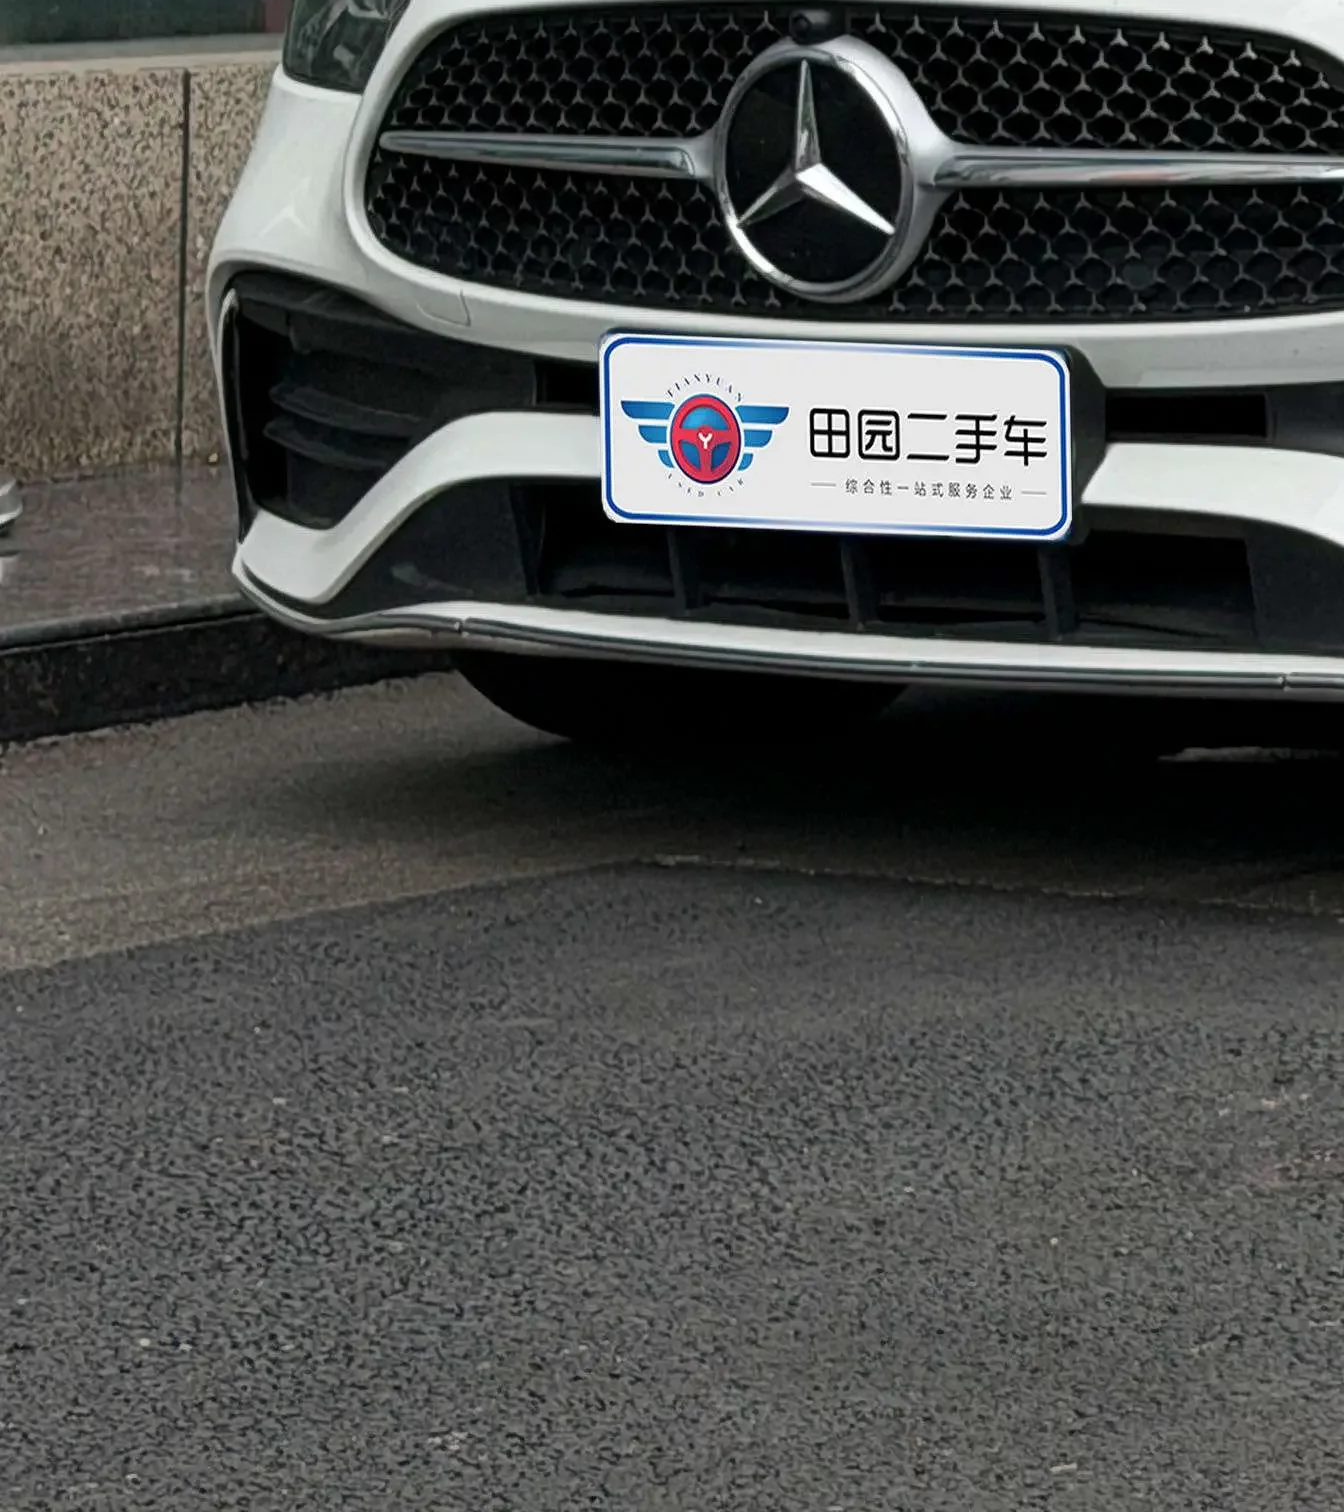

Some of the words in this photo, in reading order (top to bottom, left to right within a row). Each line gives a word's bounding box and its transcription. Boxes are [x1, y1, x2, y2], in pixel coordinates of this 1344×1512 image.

[809, 408, 1048, 466] 田园二手车
[845, 478, 1012, 501] 综合性一站式服务企业
